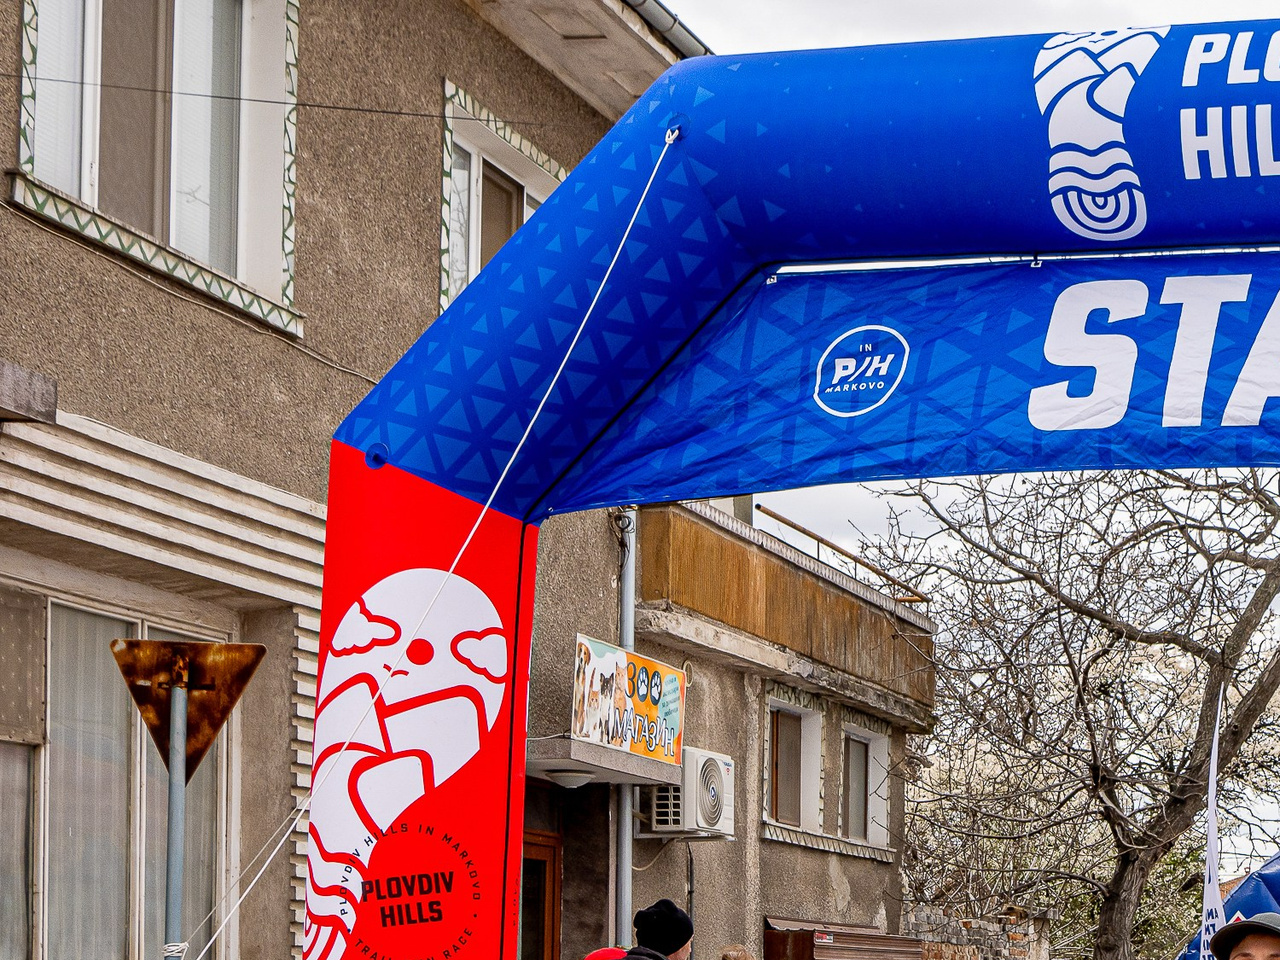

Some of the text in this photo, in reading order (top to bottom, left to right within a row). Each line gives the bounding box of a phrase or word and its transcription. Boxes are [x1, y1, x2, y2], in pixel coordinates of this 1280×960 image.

[859, 343, 872, 352] IN
[831, 353, 895, 385] P/H
[824, 381, 885, 393] MARKOVO
[612, 707, 675, 756] МАГАЗИН
[361, 871, 454, 902] PLOVDIV
[380, 900, 443, 927] HILLS
[443, 927, 472, 959] RACE
